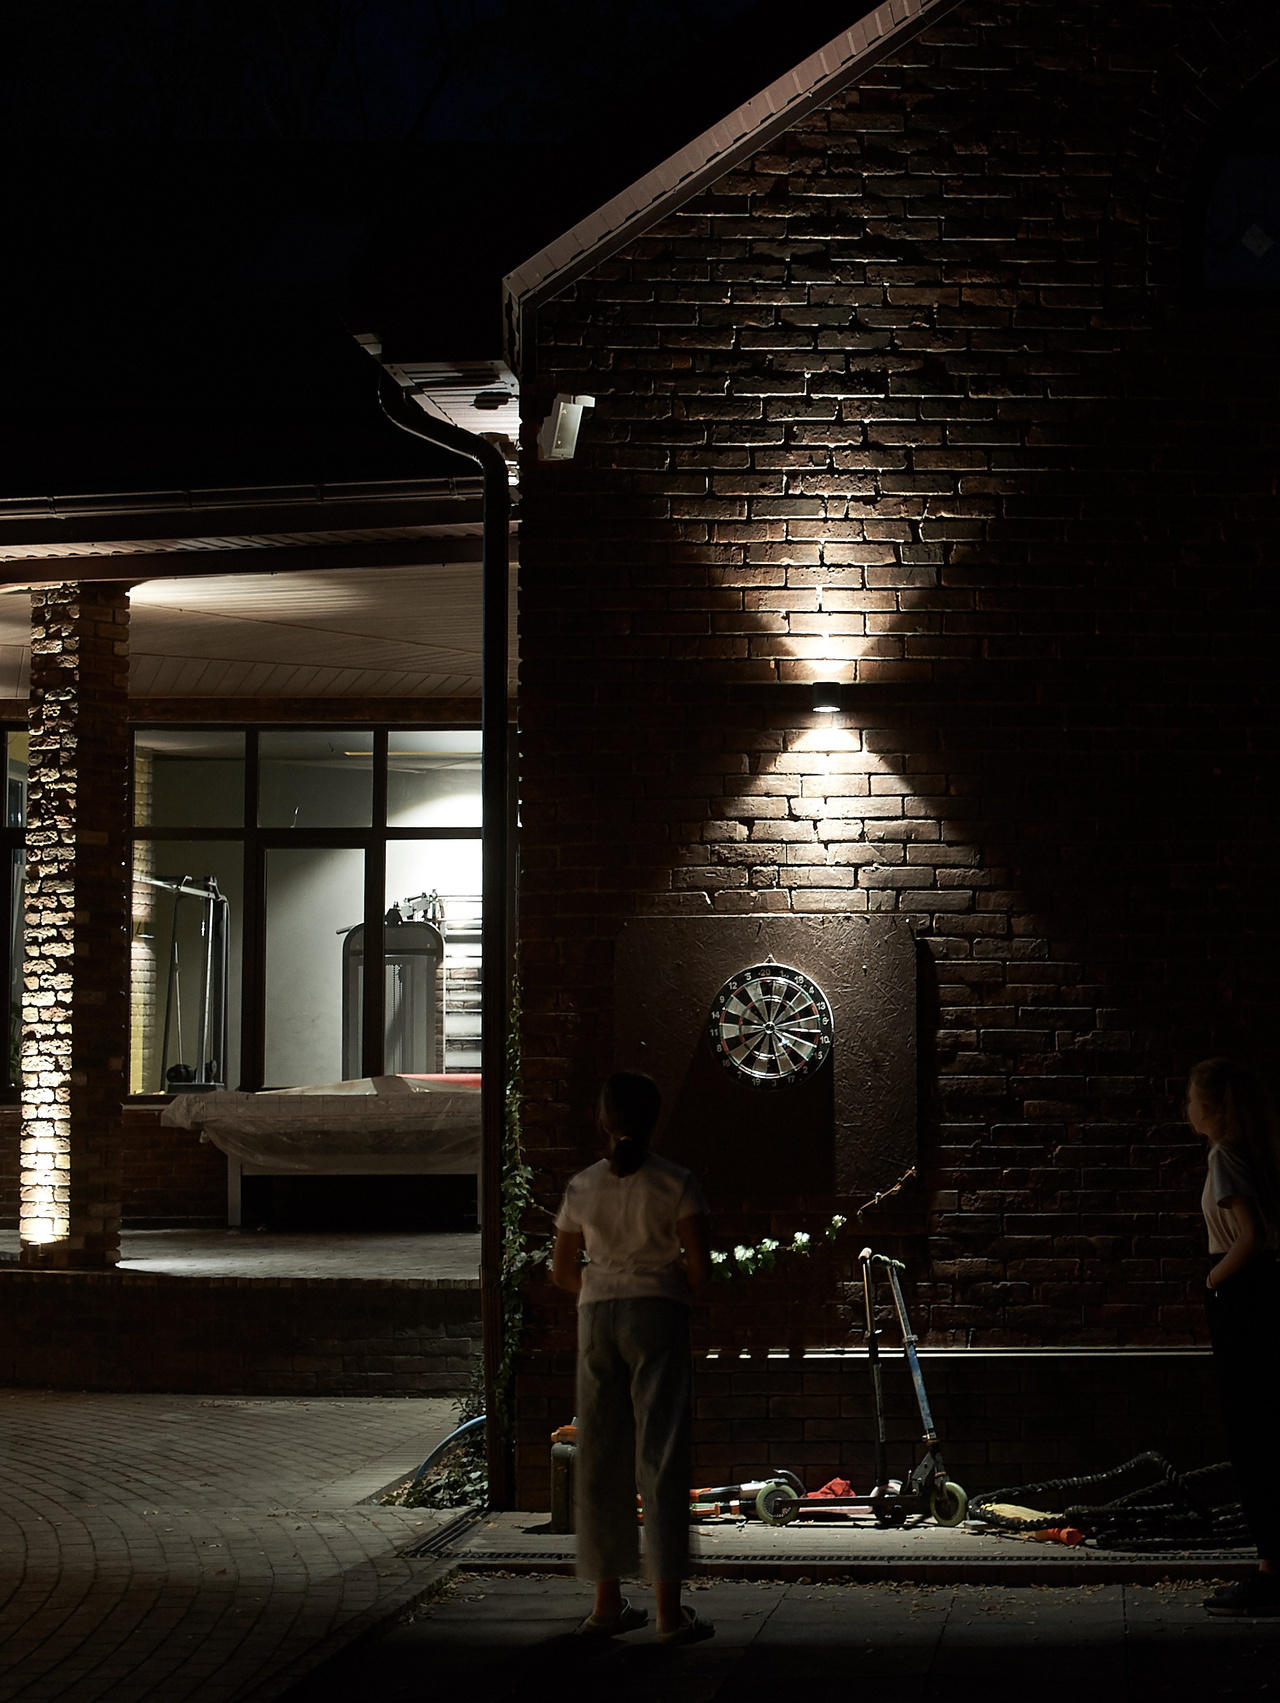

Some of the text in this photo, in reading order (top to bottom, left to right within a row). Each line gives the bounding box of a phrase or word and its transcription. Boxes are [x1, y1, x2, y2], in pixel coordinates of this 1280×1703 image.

[760, 968, 771, 977] 20
[728, 981, 738, 990] 12
[816, 1001, 826, 1010] 13
[711, 1011, 720, 1019] 14
[710, 1028, 718, 1036] 11
[820, 1035, 830, 1044] 10
[752, 1077, 761, 1086] 19
[787, 1075, 797, 1083] 17
